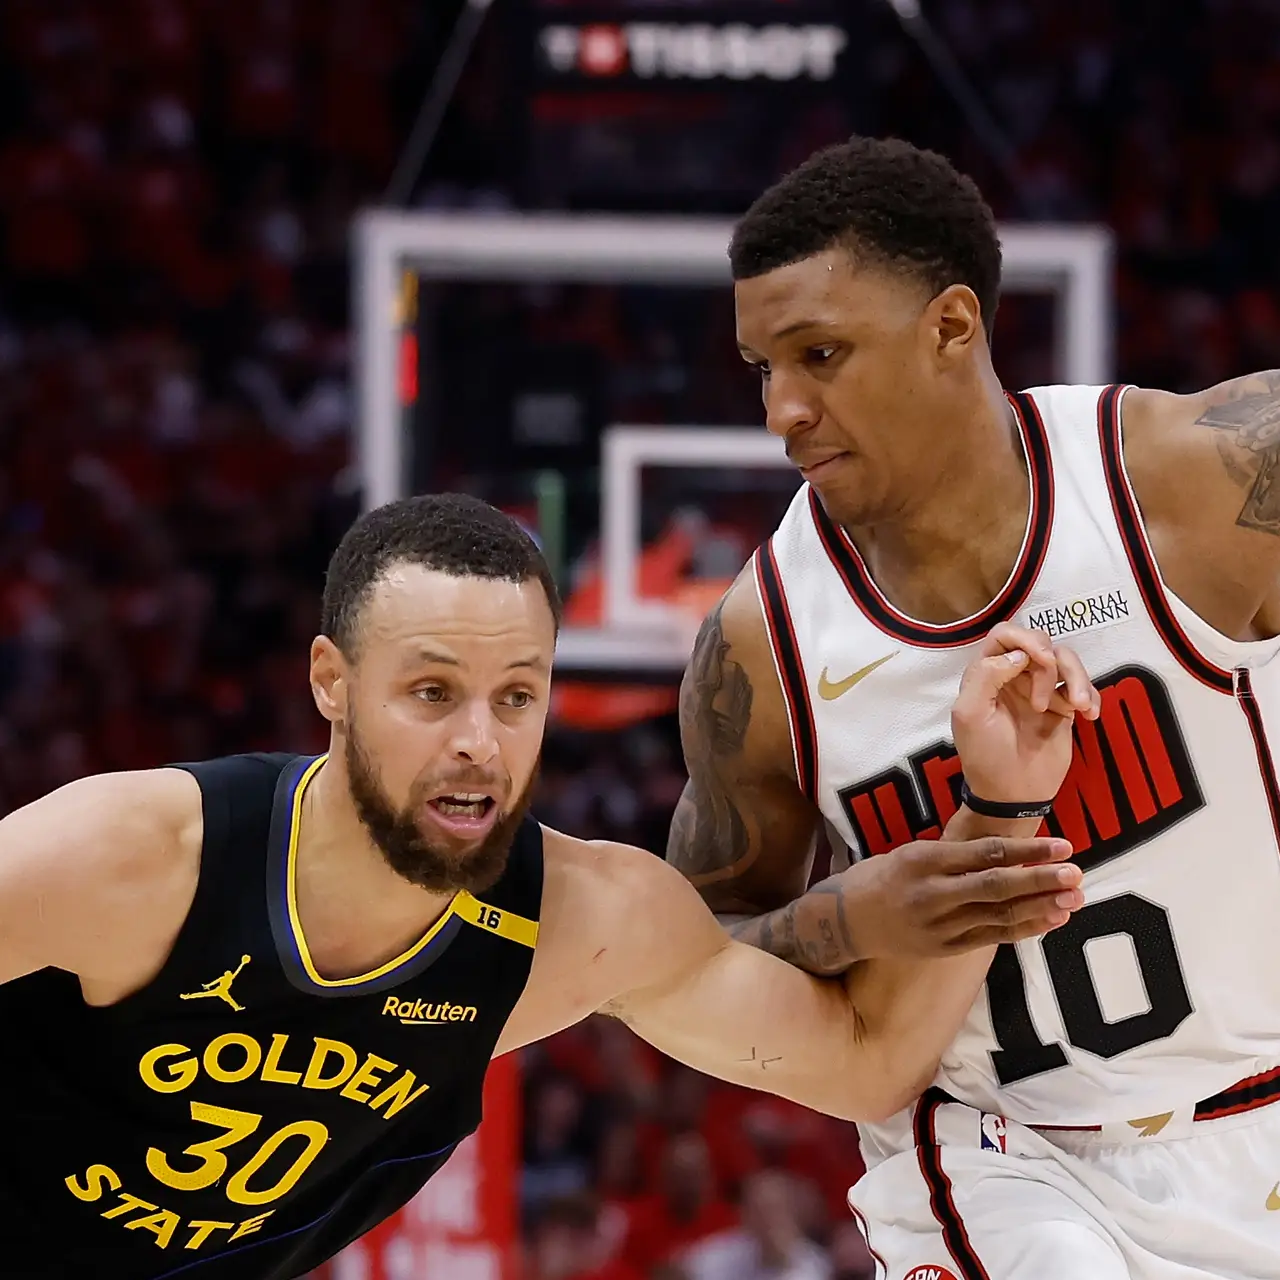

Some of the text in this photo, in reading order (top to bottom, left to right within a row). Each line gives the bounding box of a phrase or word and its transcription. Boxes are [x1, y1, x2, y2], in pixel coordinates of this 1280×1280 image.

[627, 22, 847, 80] TISSOT
[1028, 589, 1128, 630] MEMORIAL
[1040, 601, 1129, 637] ERMANN
[477, 905, 502, 930] 16
[381, 996, 478, 1024] Rakuten
[985, 889, 1196, 1089] 10
[138, 1032, 430, 1120] GOLDEN
[145, 1100, 330, 1206] 30
[64, 1163, 277, 1250] STATE
